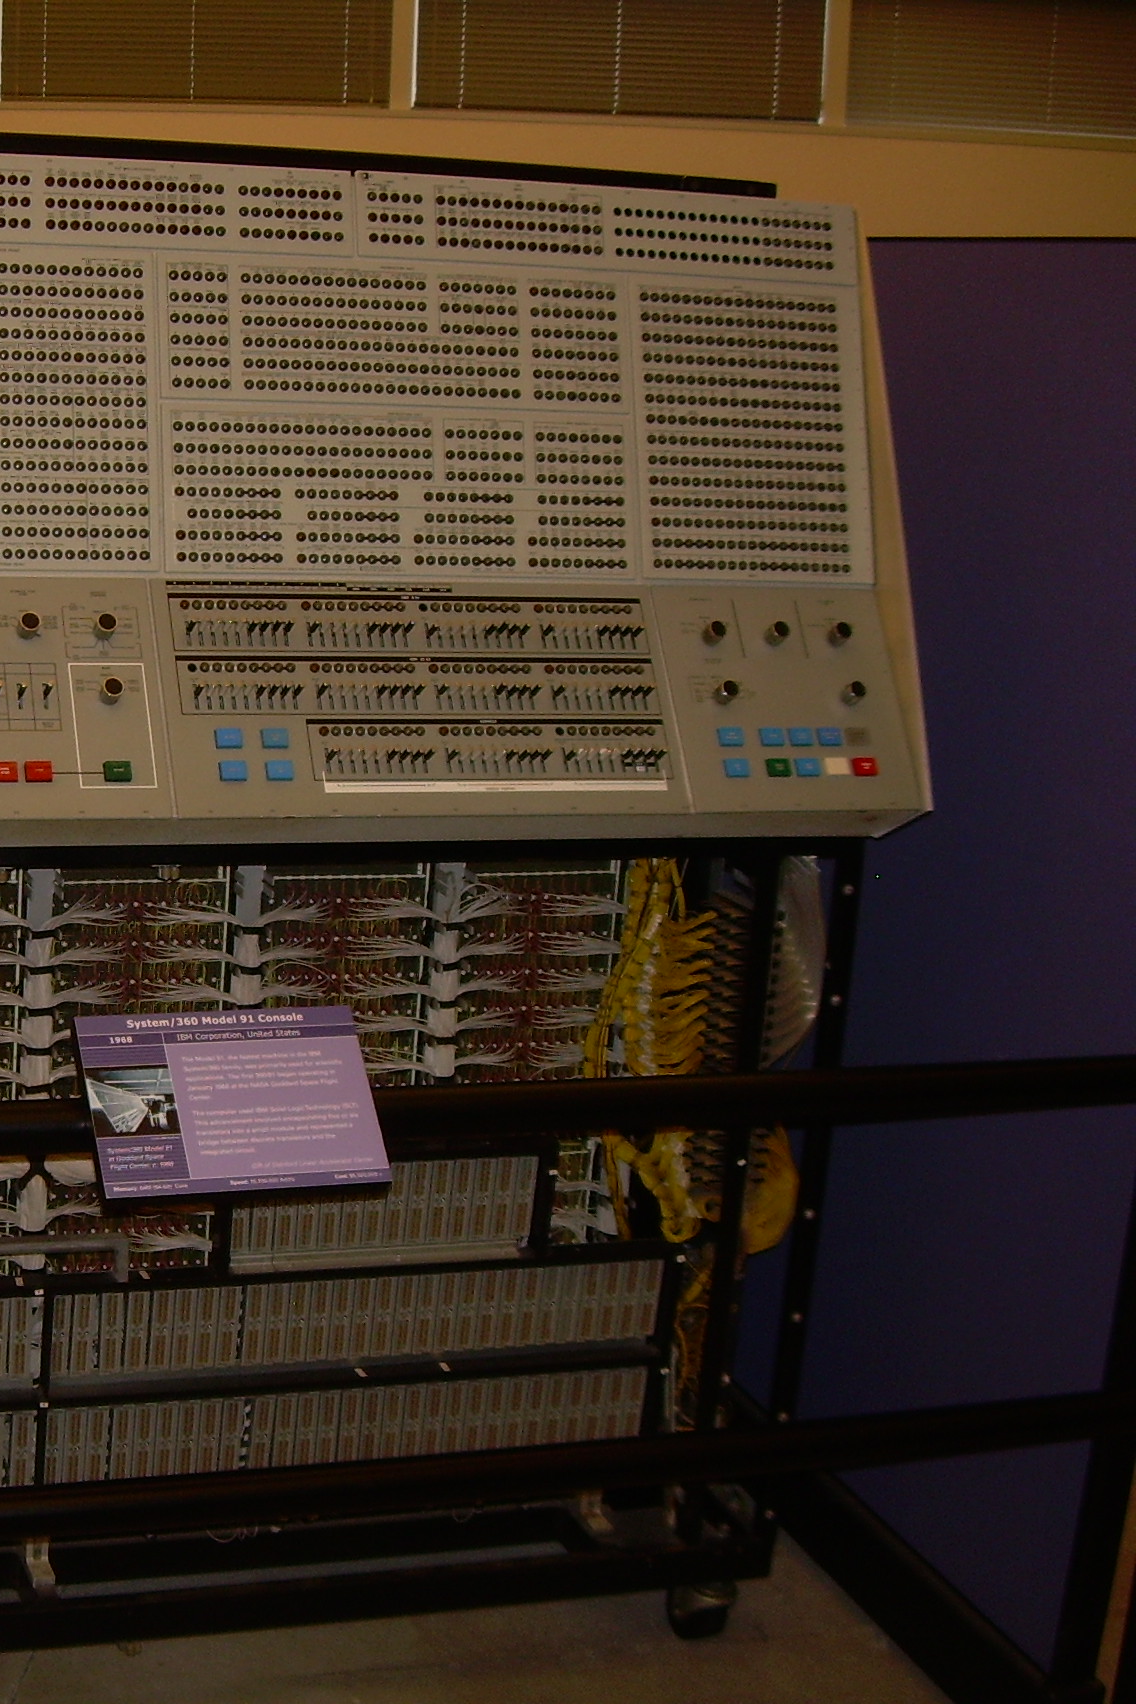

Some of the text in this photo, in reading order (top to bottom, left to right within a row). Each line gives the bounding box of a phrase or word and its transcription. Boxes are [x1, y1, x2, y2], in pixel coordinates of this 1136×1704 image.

[126, 1012, 304, 1029] System/360 Model 91 Console
[176, 1029, 301, 1041] IBM Corporation, United States
